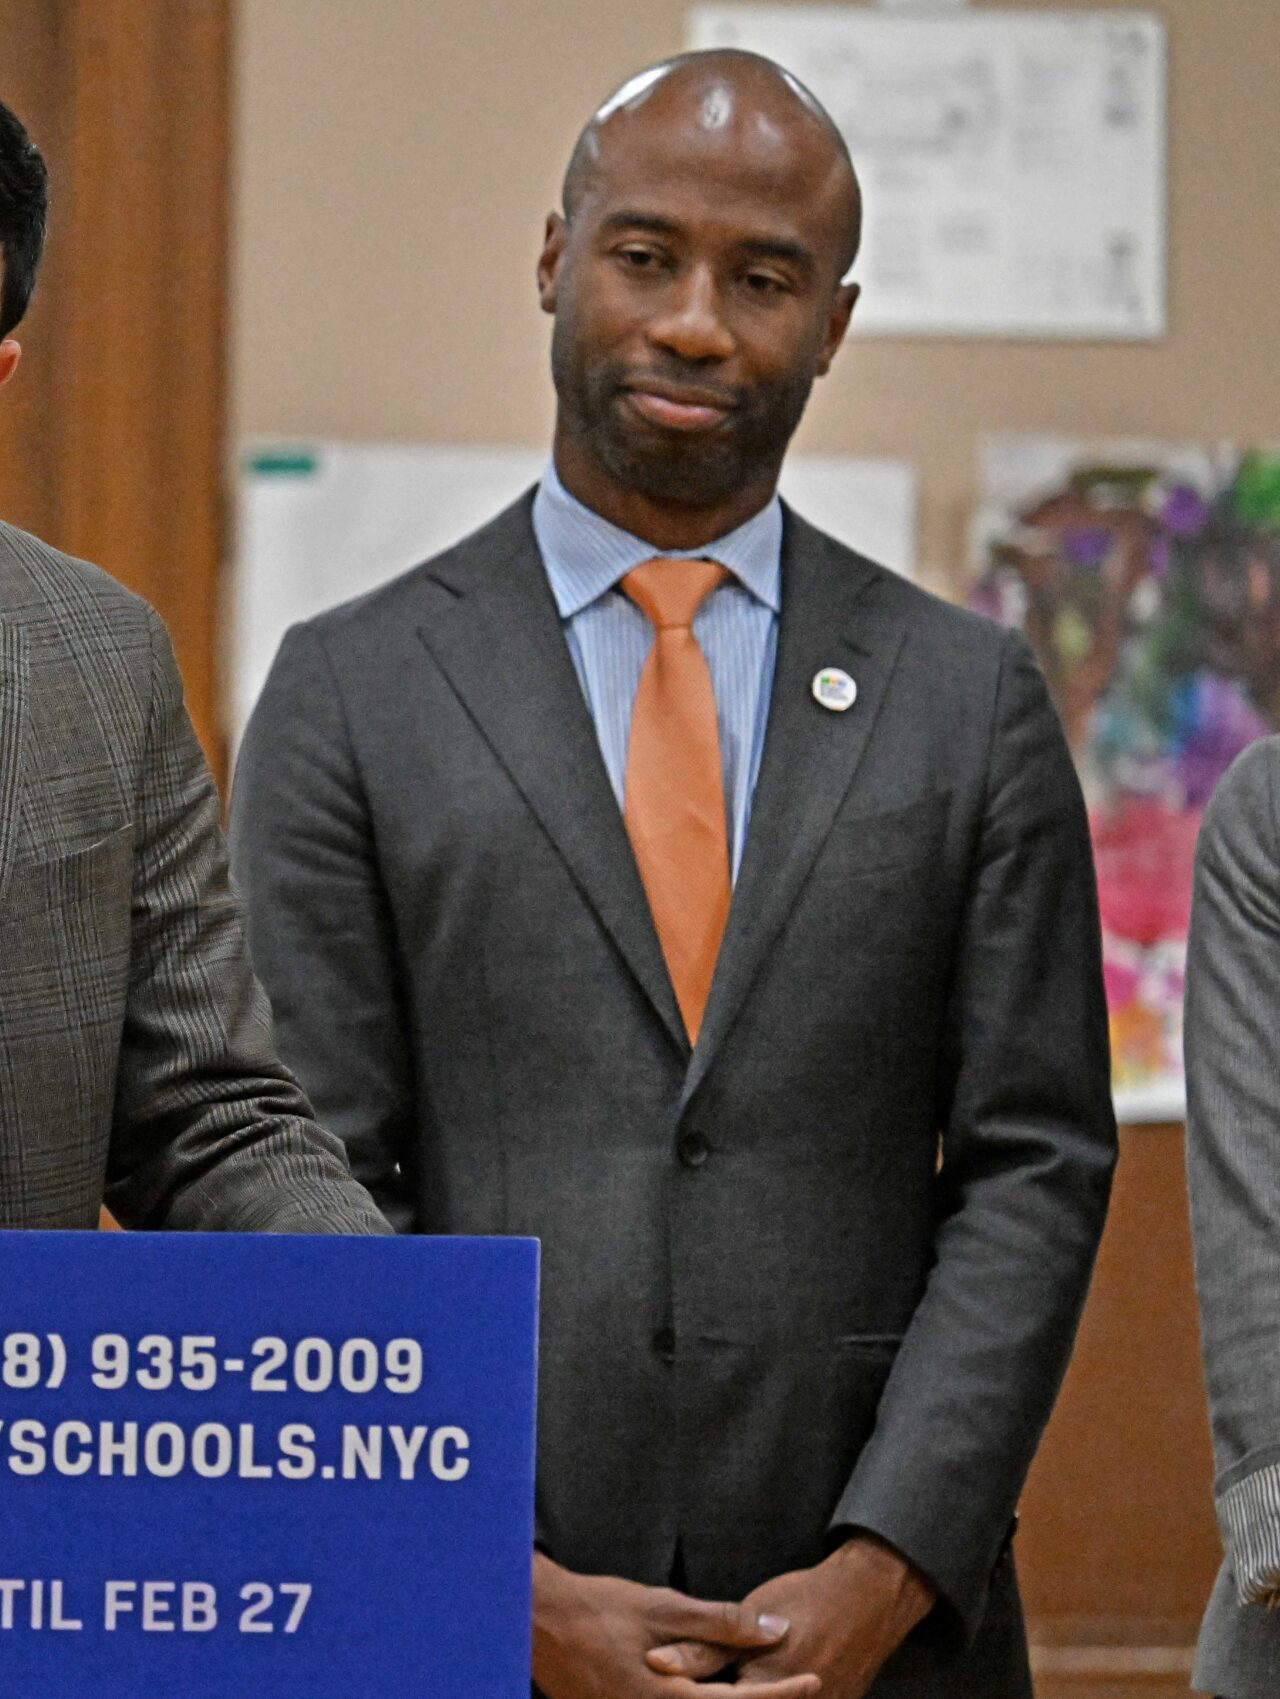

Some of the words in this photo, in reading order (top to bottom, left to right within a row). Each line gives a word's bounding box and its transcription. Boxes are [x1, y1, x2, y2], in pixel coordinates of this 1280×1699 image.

[91, 1334, 422, 1393] 935-2009
[105, 1581, 217, 1631] FEB
[239, 1583, 312, 1633] 27
